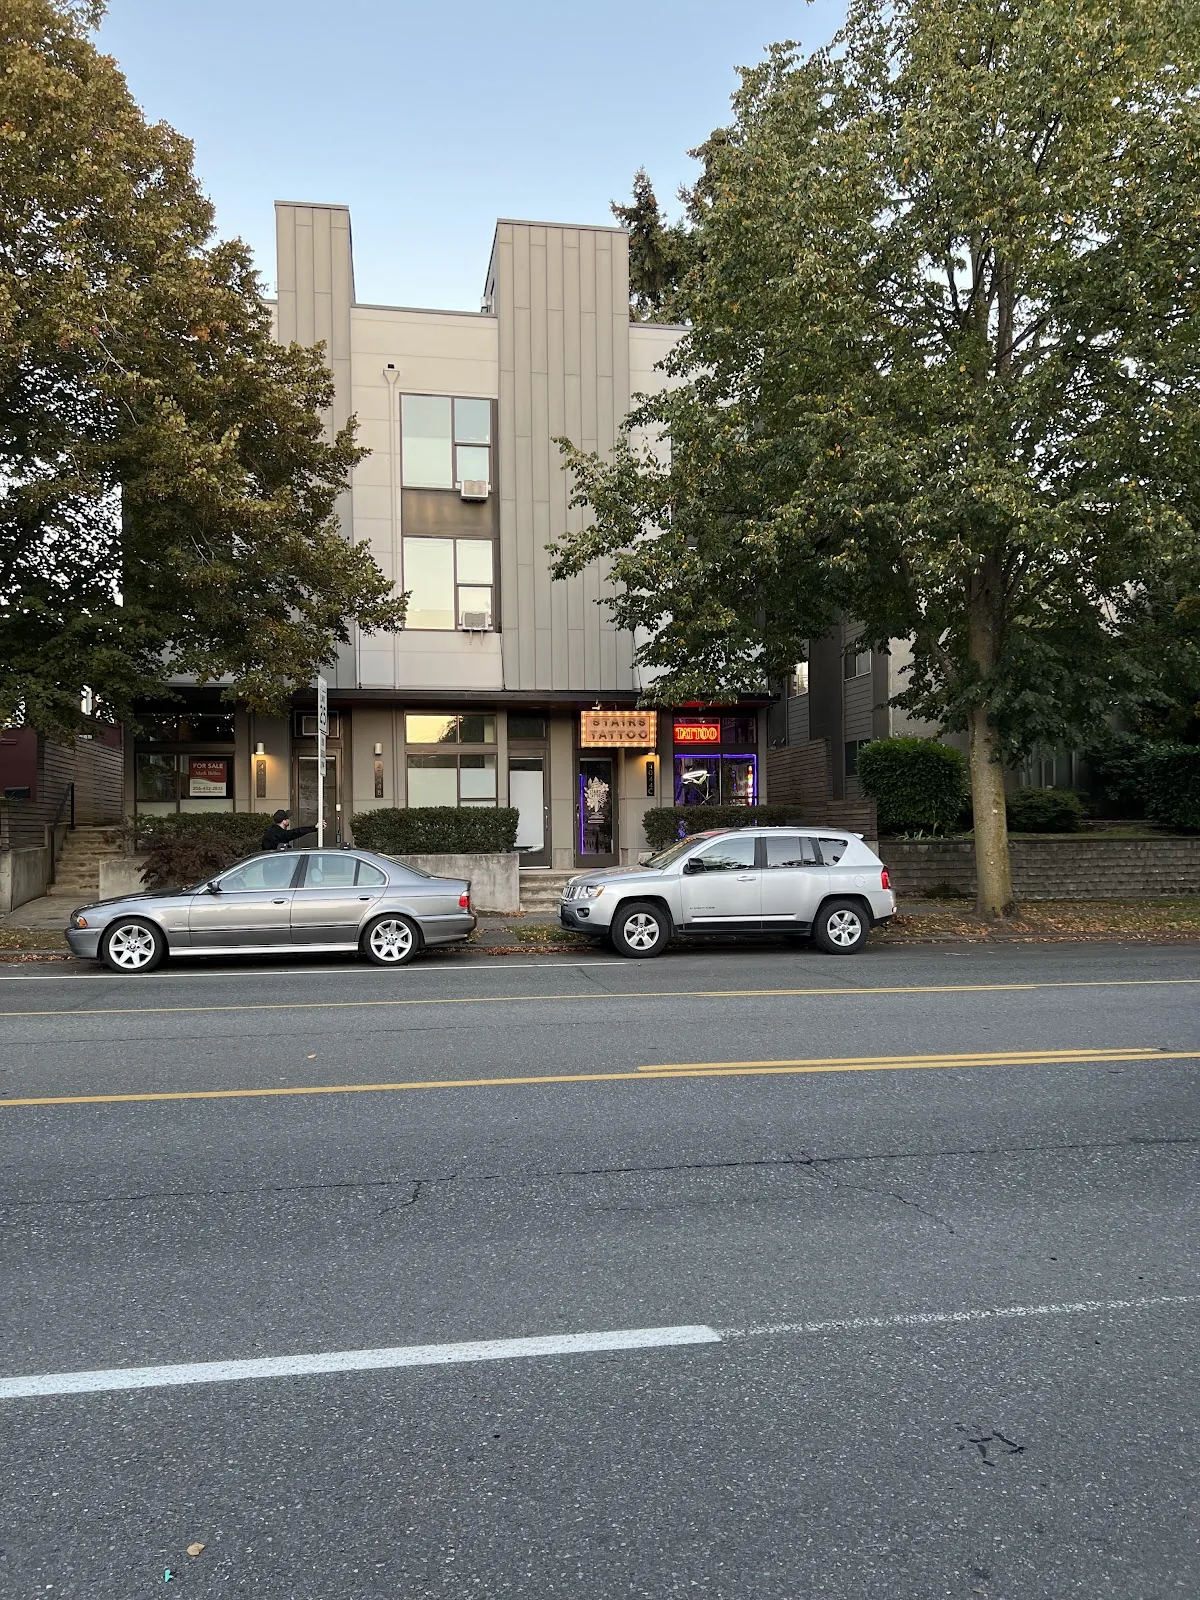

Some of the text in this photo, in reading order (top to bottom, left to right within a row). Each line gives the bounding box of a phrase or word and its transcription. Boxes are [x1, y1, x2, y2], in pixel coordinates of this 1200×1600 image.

[592, 717, 646, 727] STAIRS
[590, 730, 648, 740] TATTOO
[675, 727, 717, 740] TATTOO
